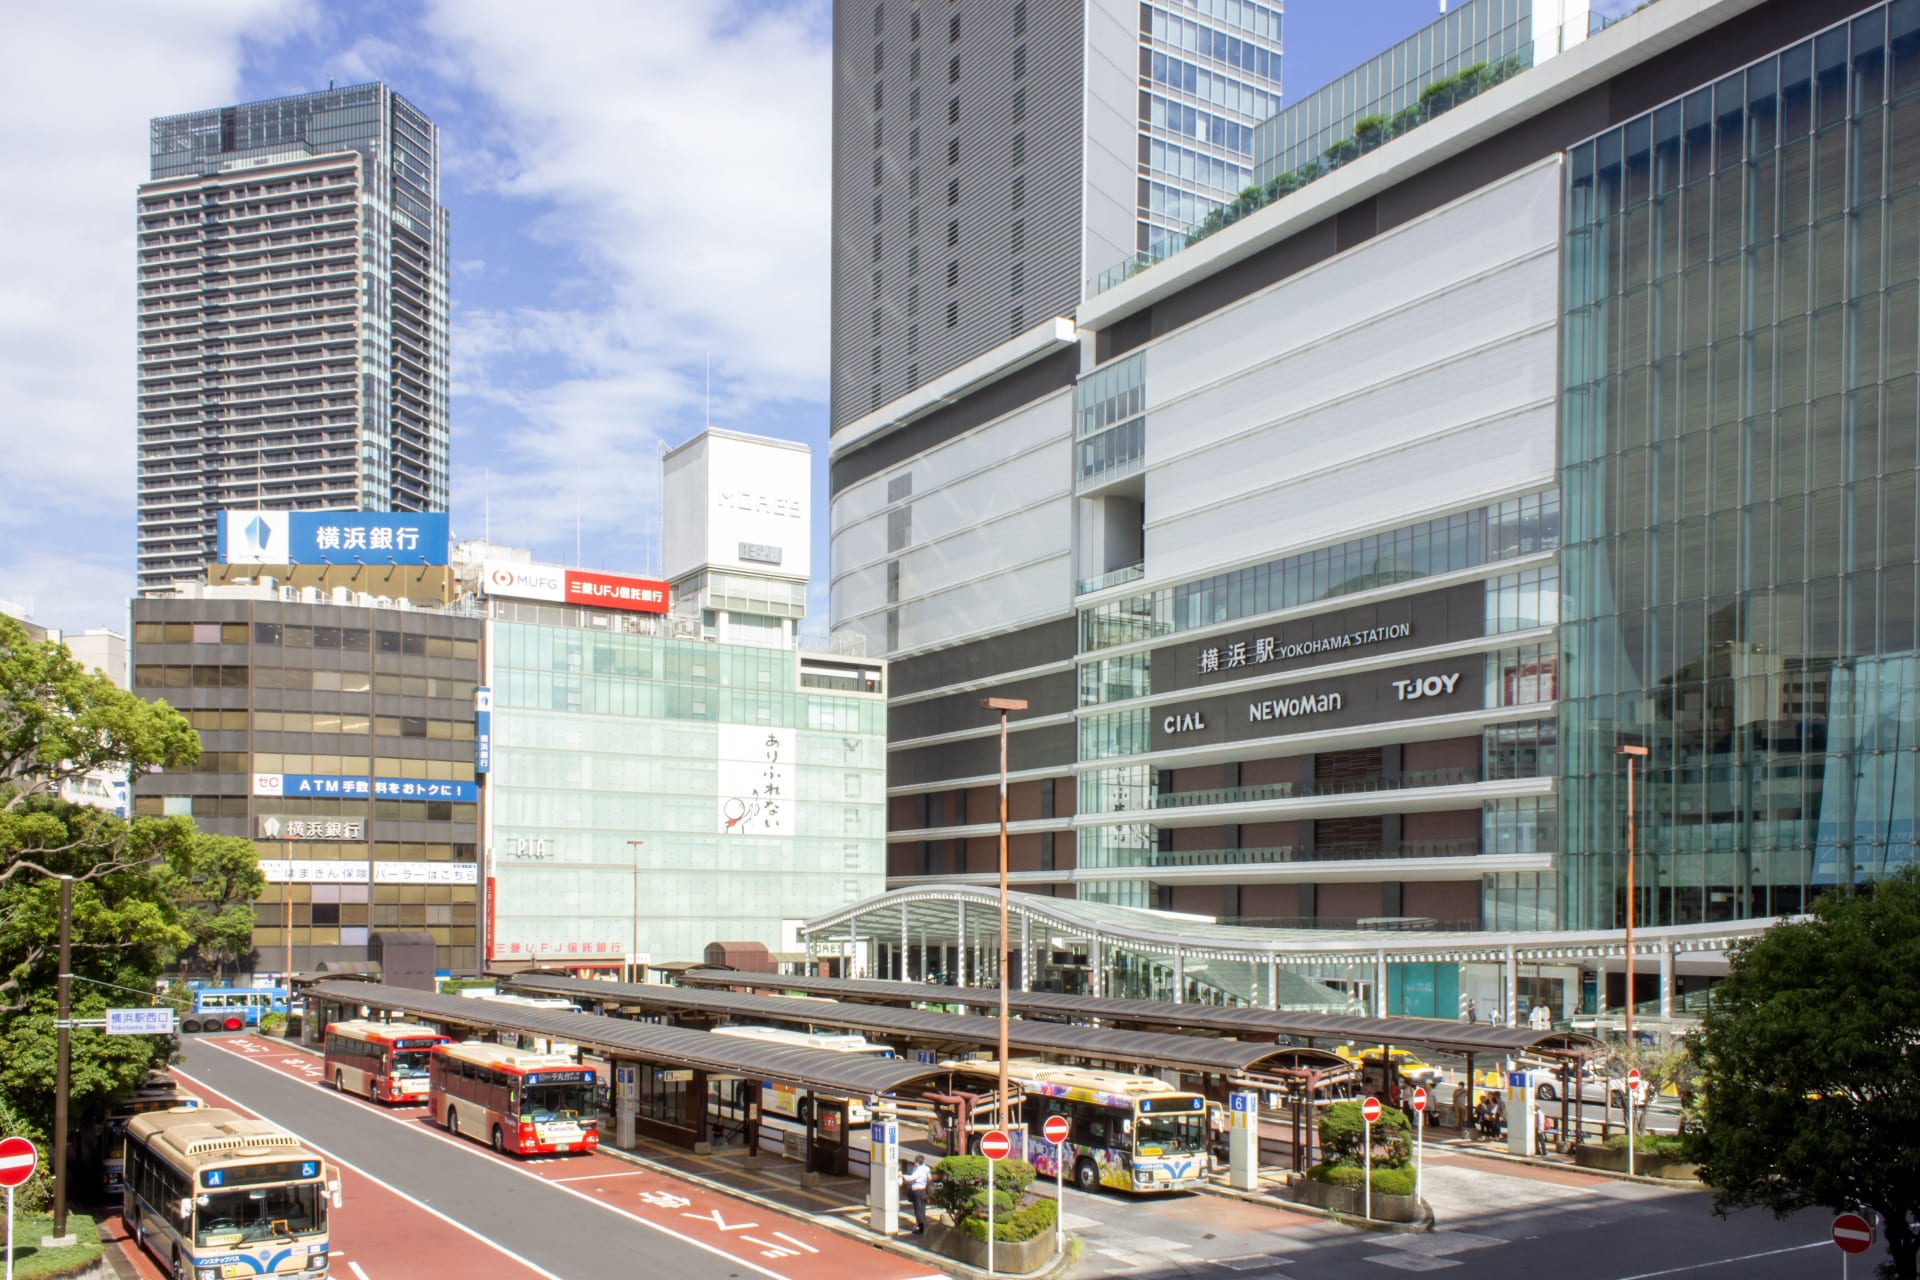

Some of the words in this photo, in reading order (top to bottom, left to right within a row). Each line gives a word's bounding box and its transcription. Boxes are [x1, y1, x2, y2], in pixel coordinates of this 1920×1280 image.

[316, 526, 420, 550] 横浜銀行
[517, 575, 558, 590] MUFG
[570, 581, 663, 603] 三菱UFJ信託銀行
[1200, 636, 1275, 673] 横浜駅
[1280, 634, 1351, 659] YOKOHAMA
[1355, 622, 1410, 645] STATION
[1249, 691, 1342, 722] NEWoMan
[1163, 711, 1205, 734] CIAL
[763, 733, 782, 829] ありふれない
[287, 820, 360, 839] 横浜銀行
[517, 838, 545, 858] PIA
[111, 1012, 168, 1024] 横浜駅西口
[1235, 1096, 1243, 1110] 6
[874, 1126, 881, 1140] 11
